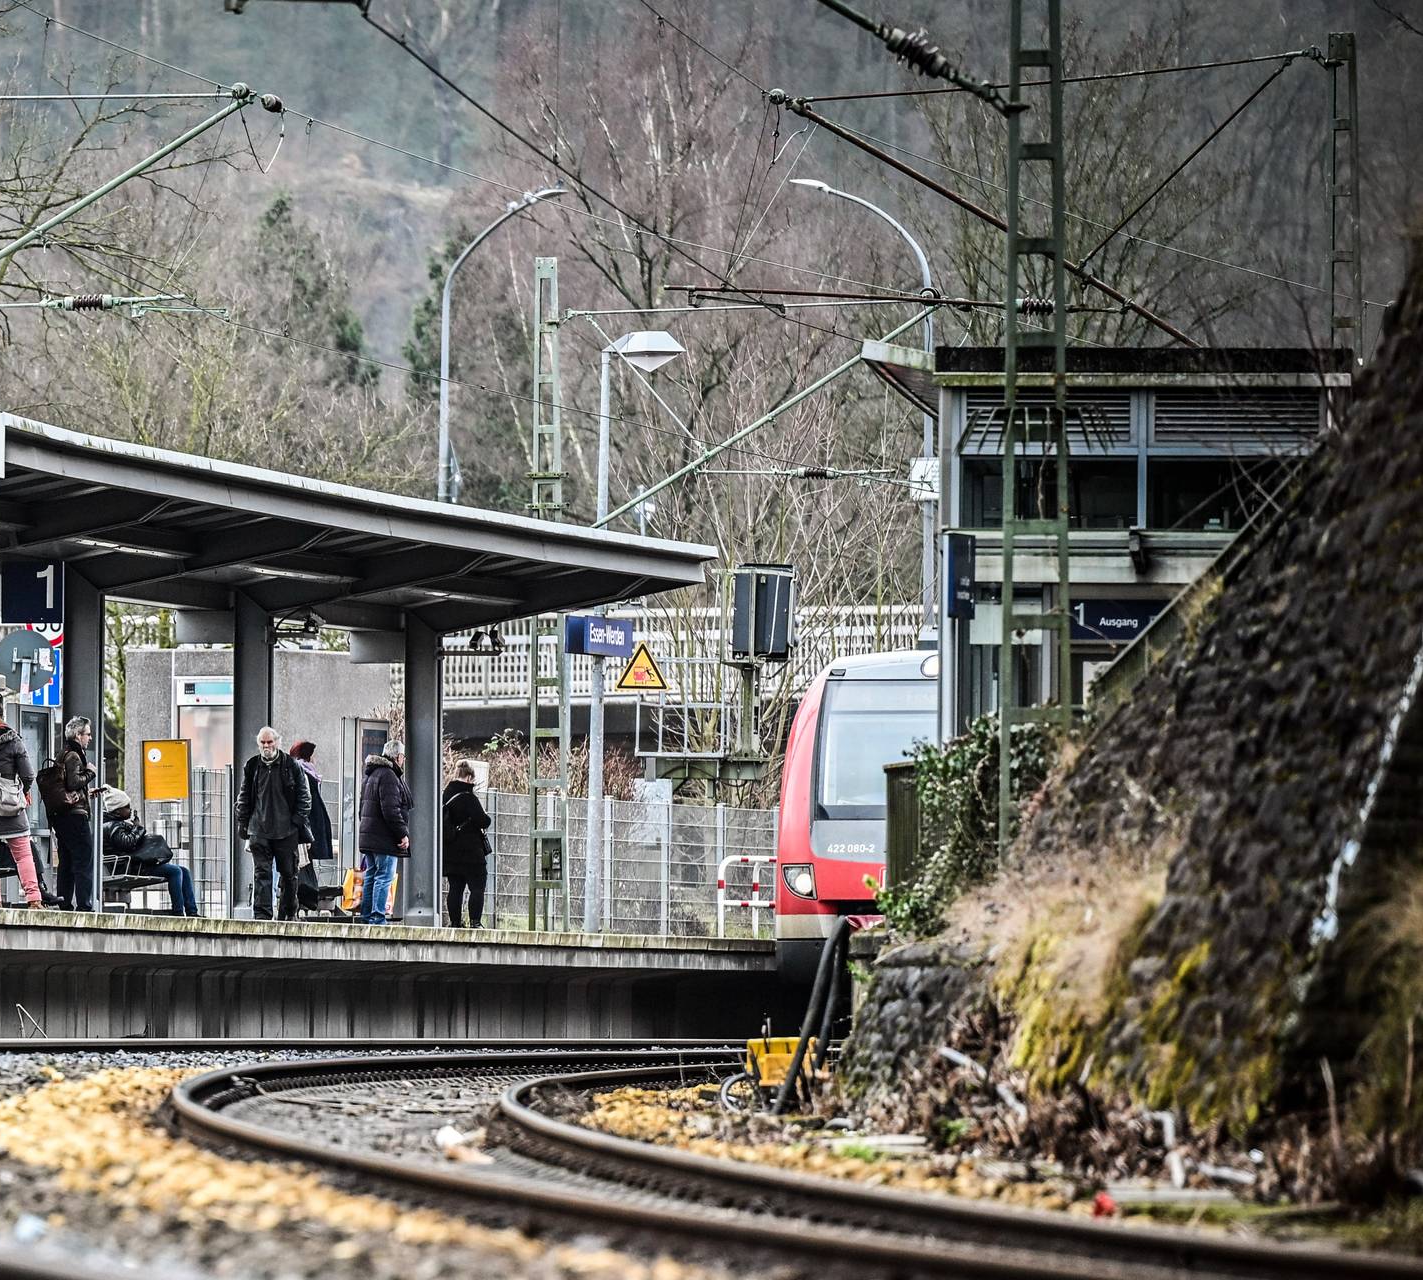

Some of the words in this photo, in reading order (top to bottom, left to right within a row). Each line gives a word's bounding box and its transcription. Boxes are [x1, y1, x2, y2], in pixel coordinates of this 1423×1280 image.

[36, 564, 54, 609] 1
[1074, 602, 1085, 626] 1
[1099, 616, 1139, 628] Ausgang
[589, 622, 625, 646] Essen-Werden
[827, 843, 846, 853] 422
[847, 843, 875, 853] 080-2
